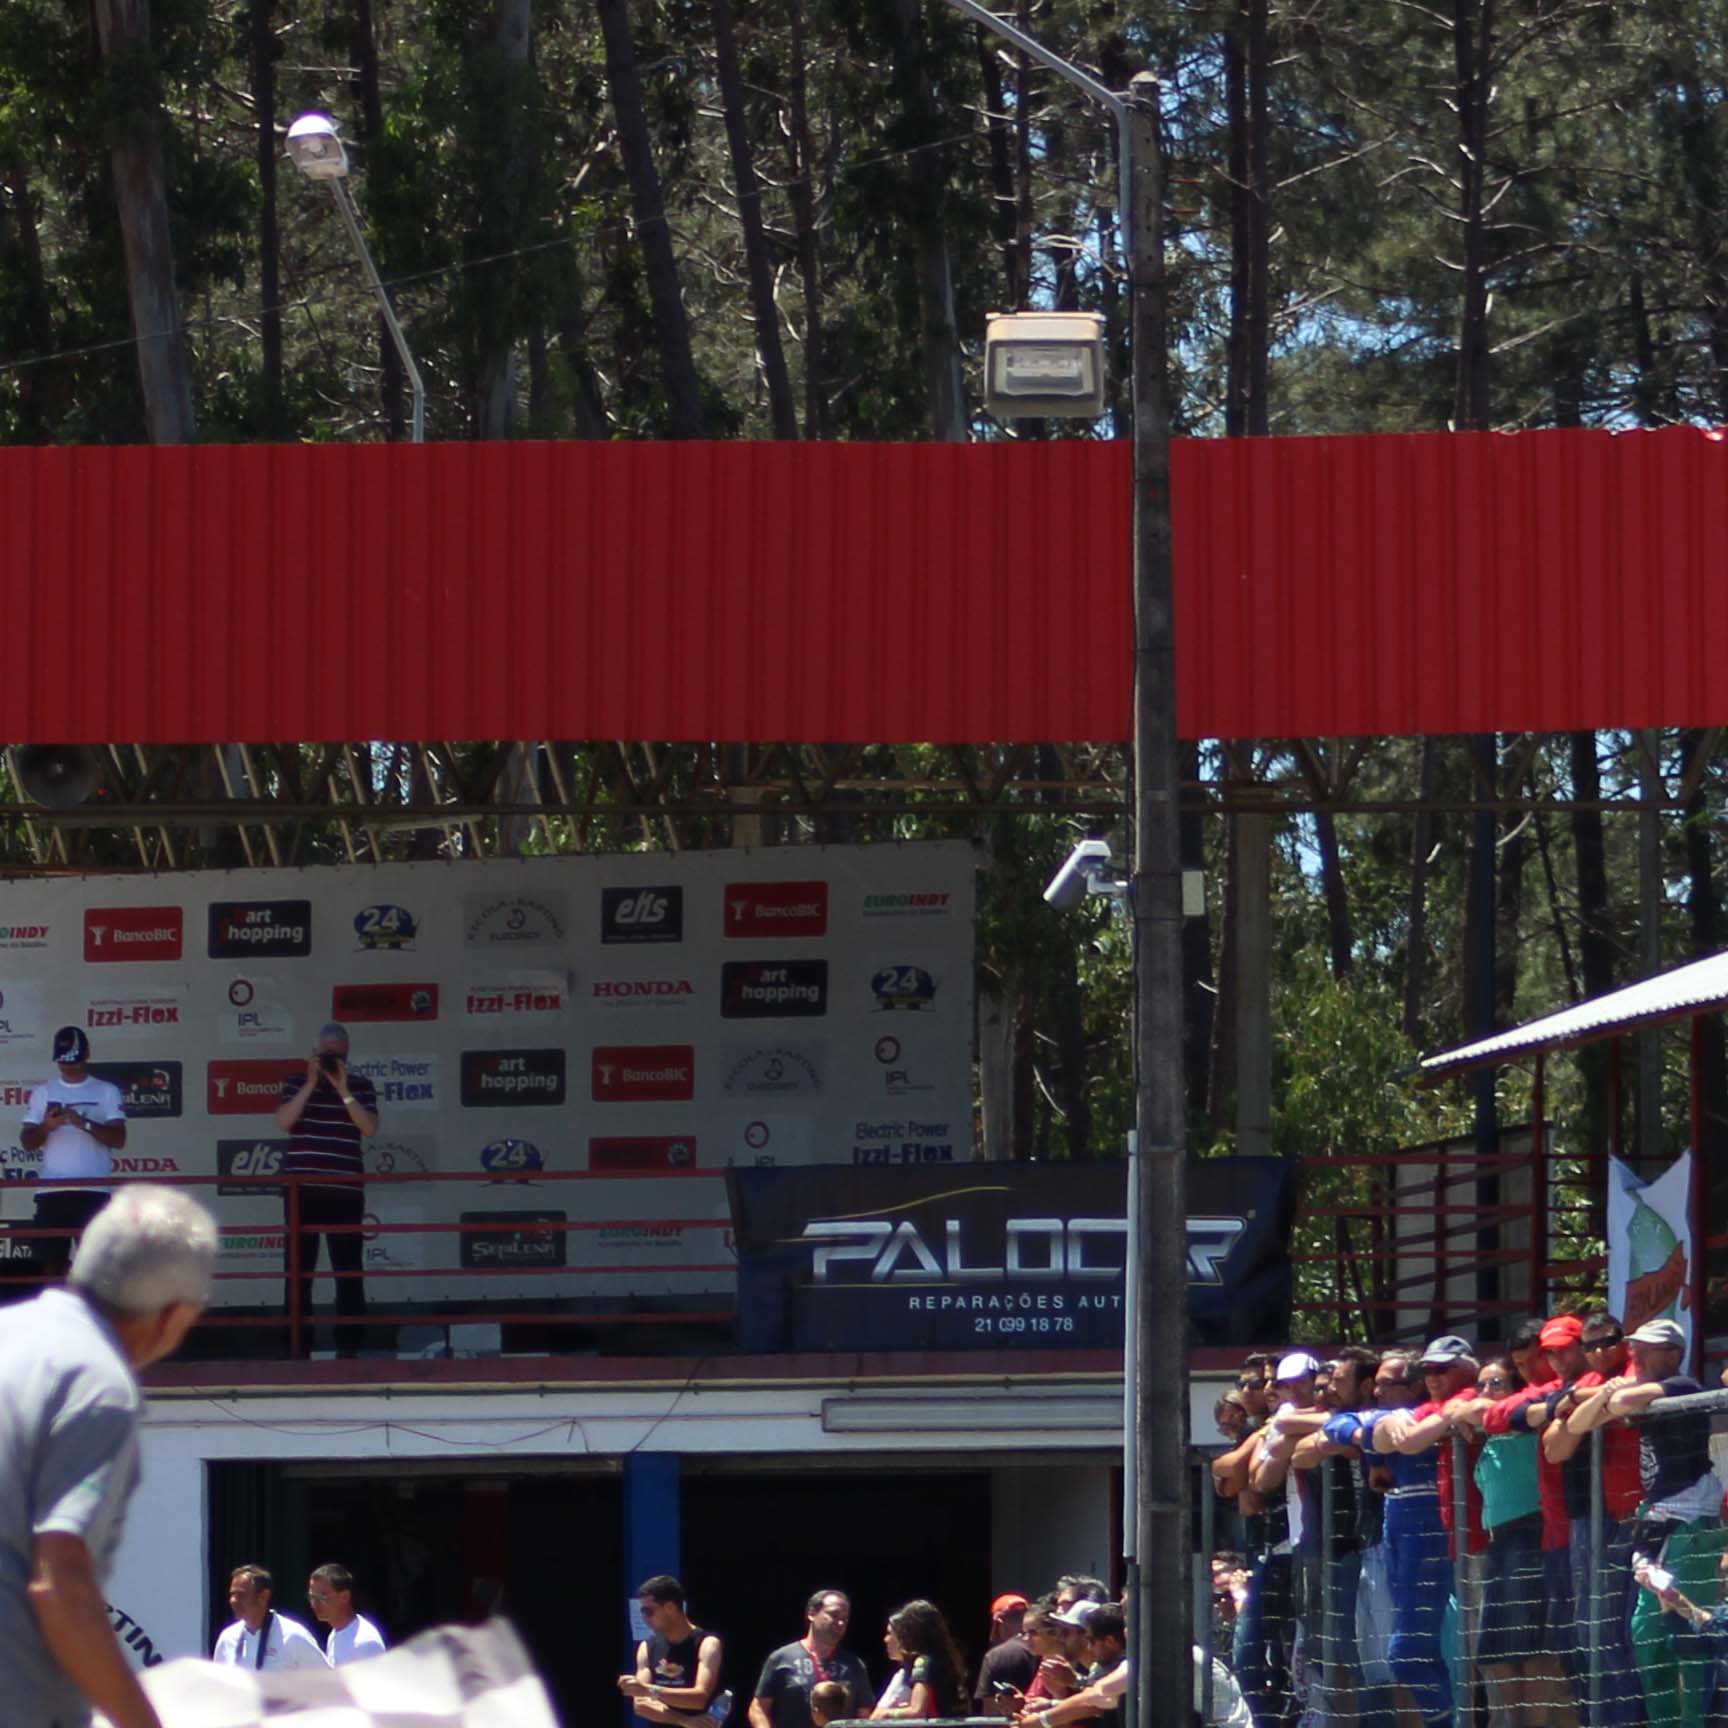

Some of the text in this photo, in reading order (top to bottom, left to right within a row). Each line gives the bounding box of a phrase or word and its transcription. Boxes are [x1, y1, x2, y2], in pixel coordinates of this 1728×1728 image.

[113, 928, 177, 944] BancoBIC
[592, 980, 696, 998] HONDA
[238, 1012, 263, 1027] IPL
[390, 1059, 432, 1077] Power
[855, 1120, 951, 1140] Electric Power
[10, 1146, 45, 1163] Powe
[803, 1216, 1247, 1284] PALOCR
[908, 1293, 1122, 1313] REPARAÇÕES AUT
[975, 1317, 992, 1333] 21
[1030, 1317, 1050, 1333] 18
[1053, 1316, 1074, 1333] 78
